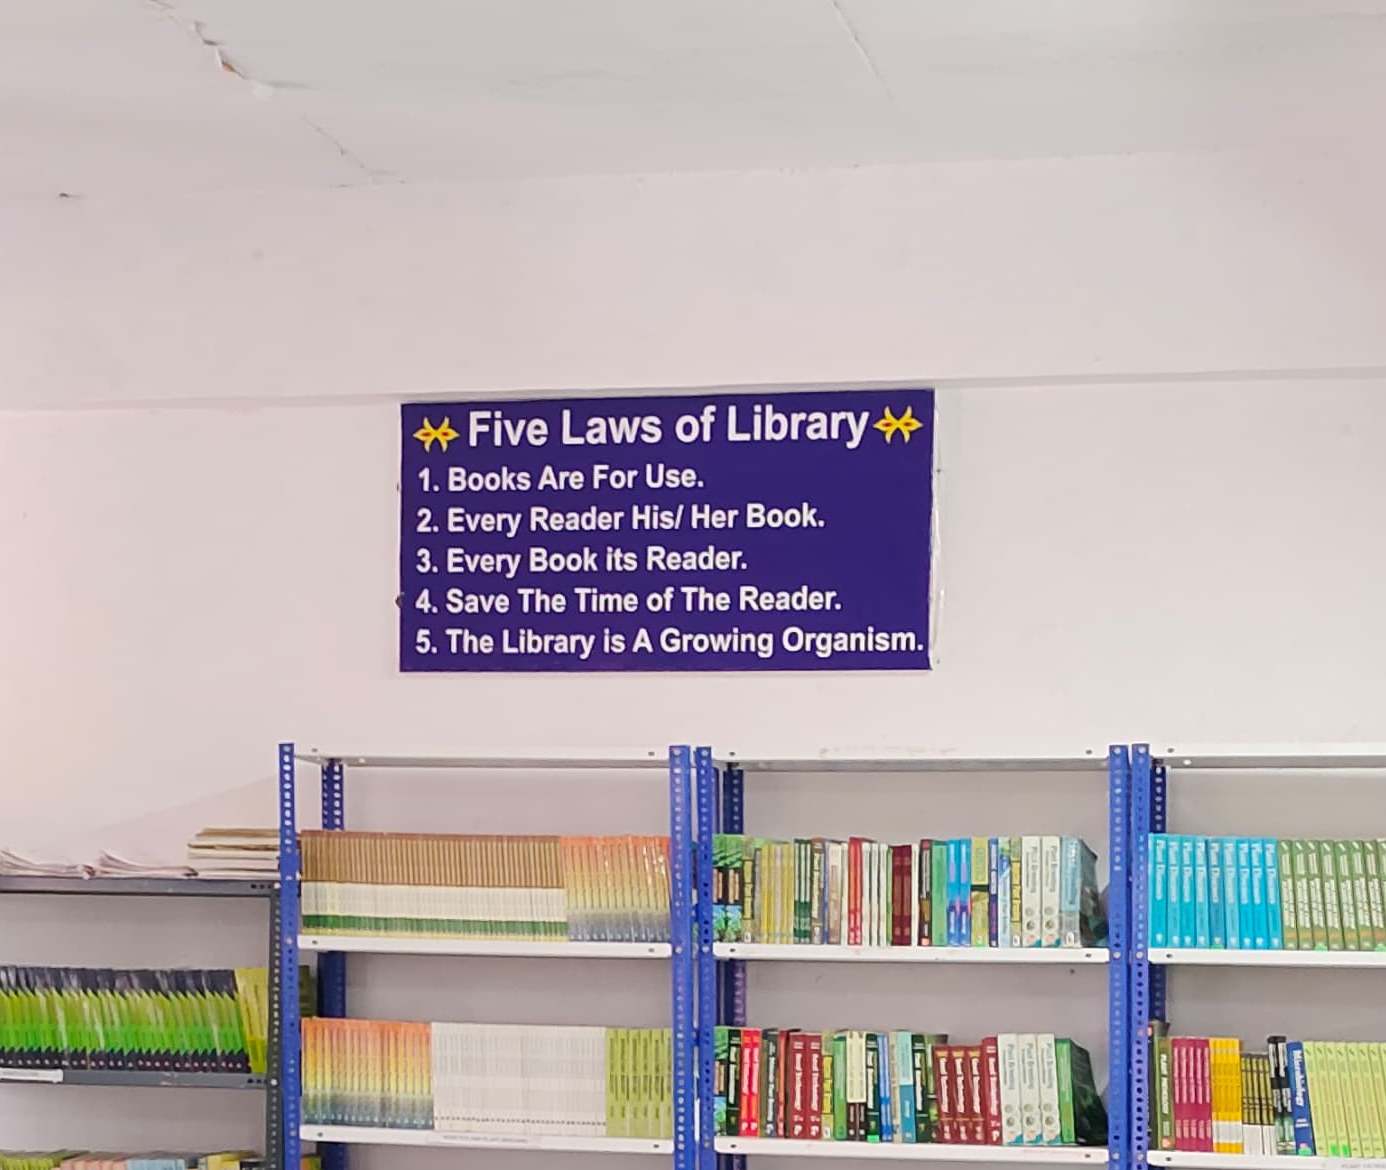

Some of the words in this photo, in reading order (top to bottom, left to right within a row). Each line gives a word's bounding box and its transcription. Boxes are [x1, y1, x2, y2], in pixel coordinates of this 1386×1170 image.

[470, 410, 548, 446] Five
[563, 409, 661, 445] Laws
[676, 405, 716, 443] of
[728, 404, 869, 448] Library
[419, 468, 439, 492] 1.
[449, 466, 530, 491] Books
[538, 466, 584, 490] Are
[594, 464, 638, 489] For
[646, 464, 703, 489] Use.
[417, 507, 438, 532] 2.
[448, 508, 521, 537] Every
[531, 505, 624, 532] Reader
[633, 504, 684, 530] His/
[692, 503, 738, 529] Her
[747, 502, 824, 528] Book.
[417, 548, 437, 572] 3.
[448, 547, 521, 579] Every
[530, 546, 597, 572] Book
[607, 546, 637, 571] its
[647, 546, 747, 571] Reader.
[416, 588, 437, 613] 4.
[446, 588, 509, 614] Save
[518, 589, 566, 613] The
[574, 587, 638, 612] Time
[647, 587, 674, 612] of
[681, 587, 730, 612] The
[740, 585, 841, 611] Reader.
[416, 629, 437, 654] 5.
[446, 628, 493, 654] The
[503, 628, 595, 660] Library
[604, 628, 625, 654] is
[633, 628, 653, 653] A
[661, 627, 773, 657] Growing
[783, 626, 923, 658] Organism.
